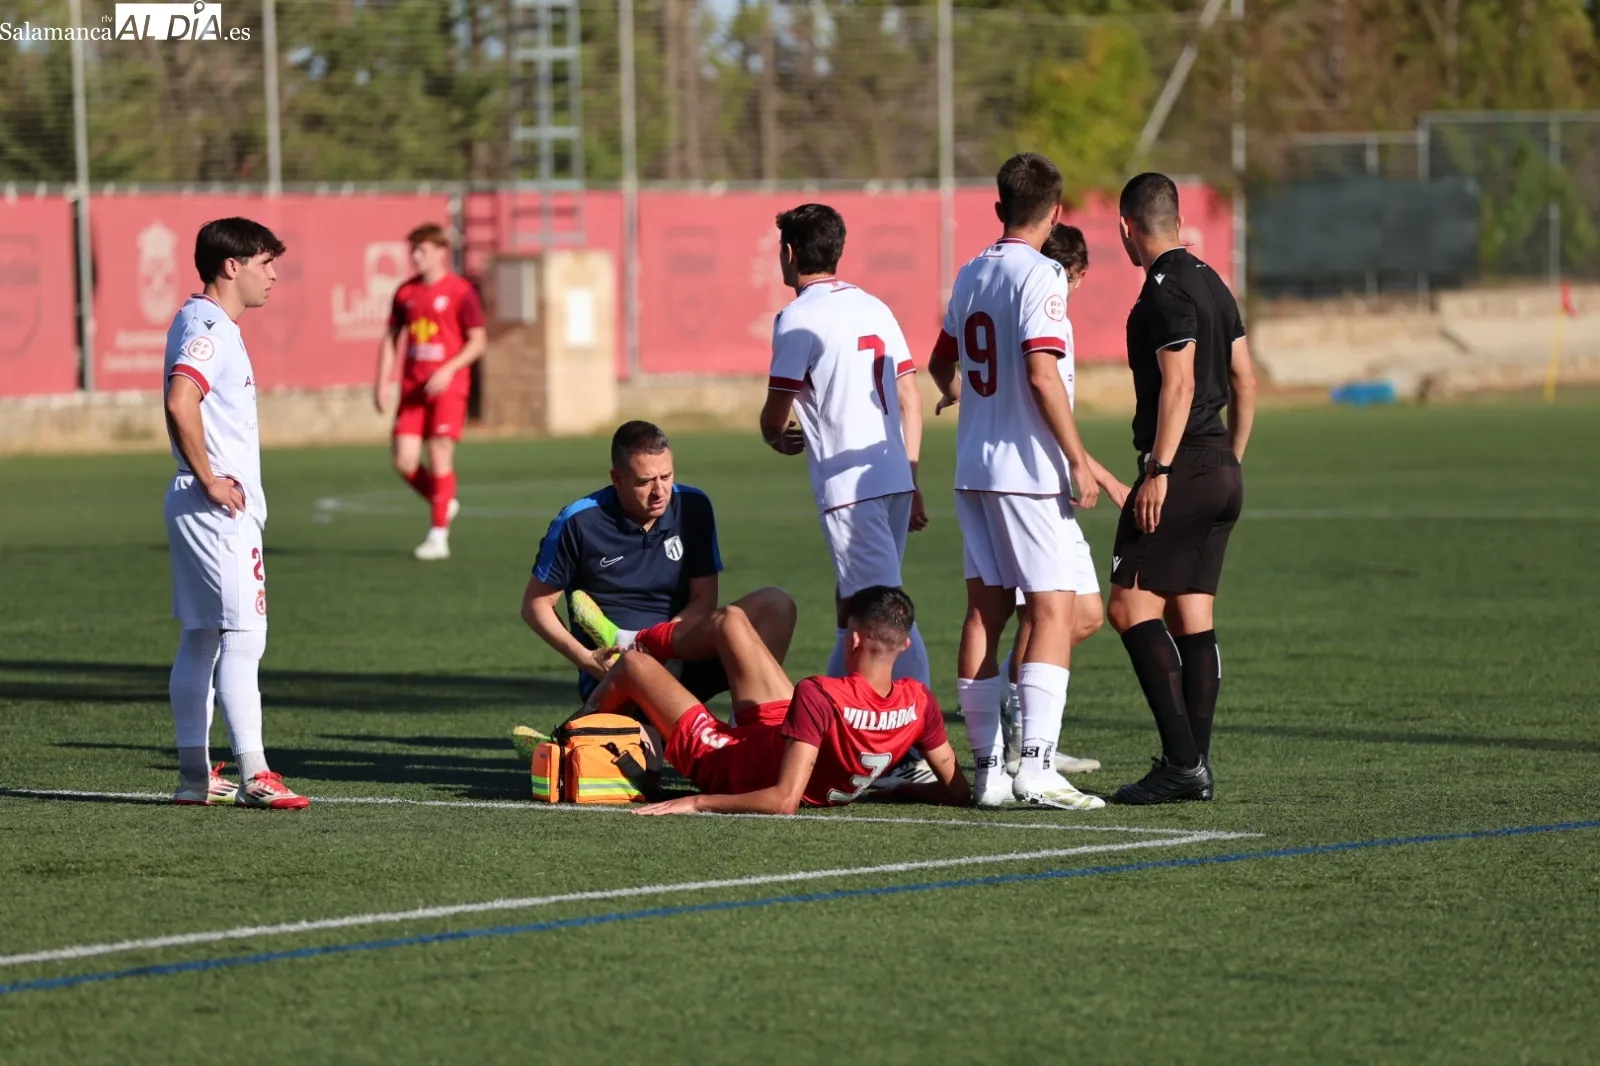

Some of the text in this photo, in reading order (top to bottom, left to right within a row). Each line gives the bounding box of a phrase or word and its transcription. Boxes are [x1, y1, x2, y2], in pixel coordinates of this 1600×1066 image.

[857, 334, 888, 416] 7
[964, 311, 998, 397] 9
[252, 547, 264, 581] 2
[827, 751, 893, 803] 3
